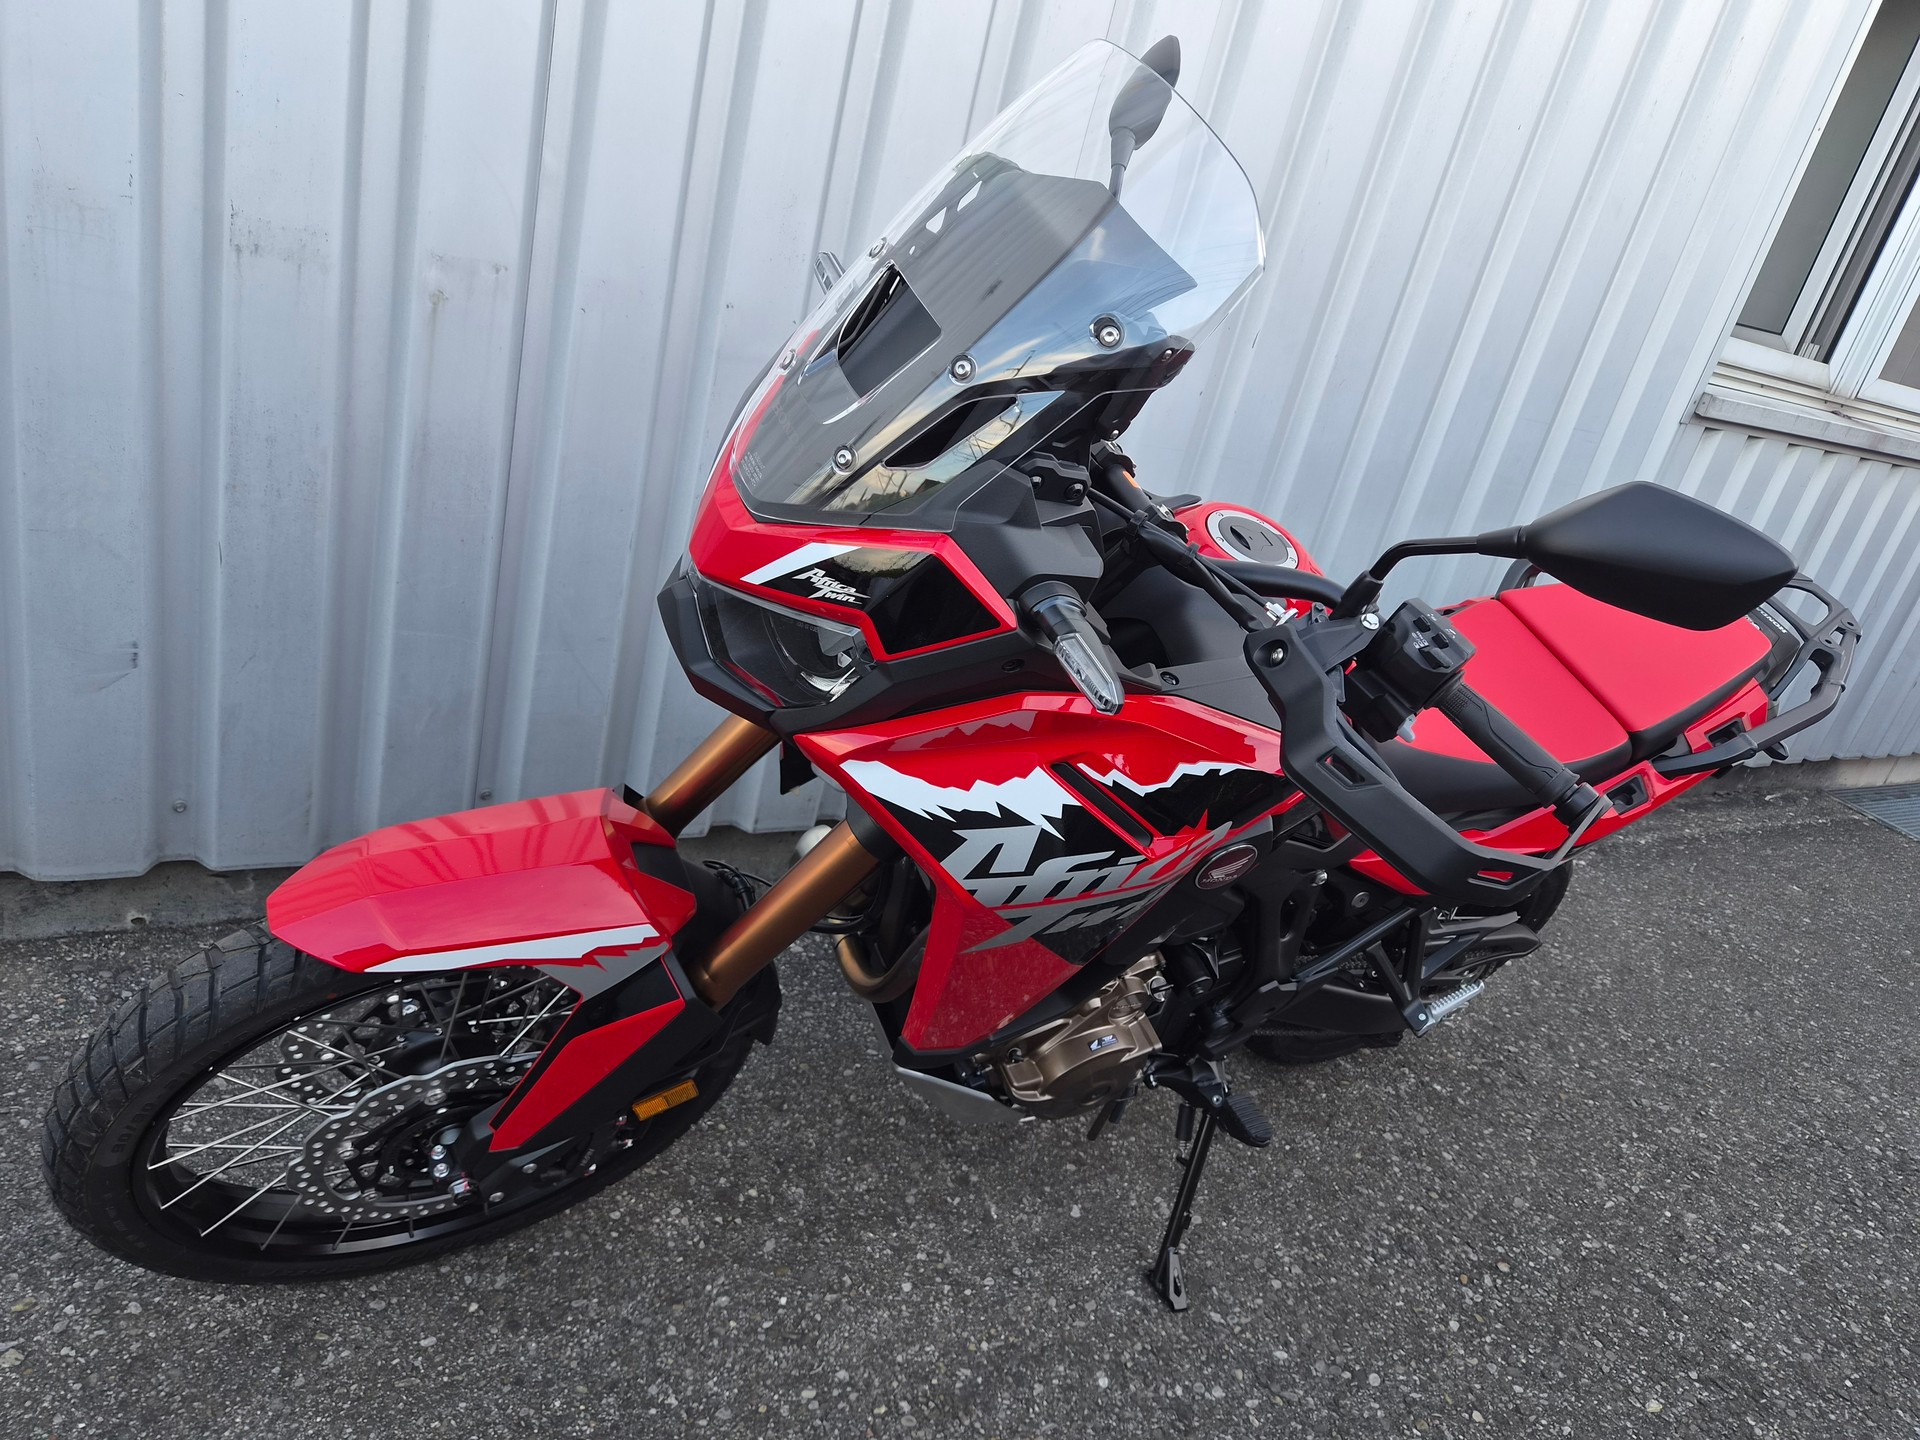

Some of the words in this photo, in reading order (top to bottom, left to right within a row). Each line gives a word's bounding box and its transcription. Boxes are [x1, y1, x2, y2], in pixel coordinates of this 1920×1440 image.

[792, 567, 857, 594] Africa
[808, 585, 868, 605] Twin
[940, 821, 1232, 908] Africa
